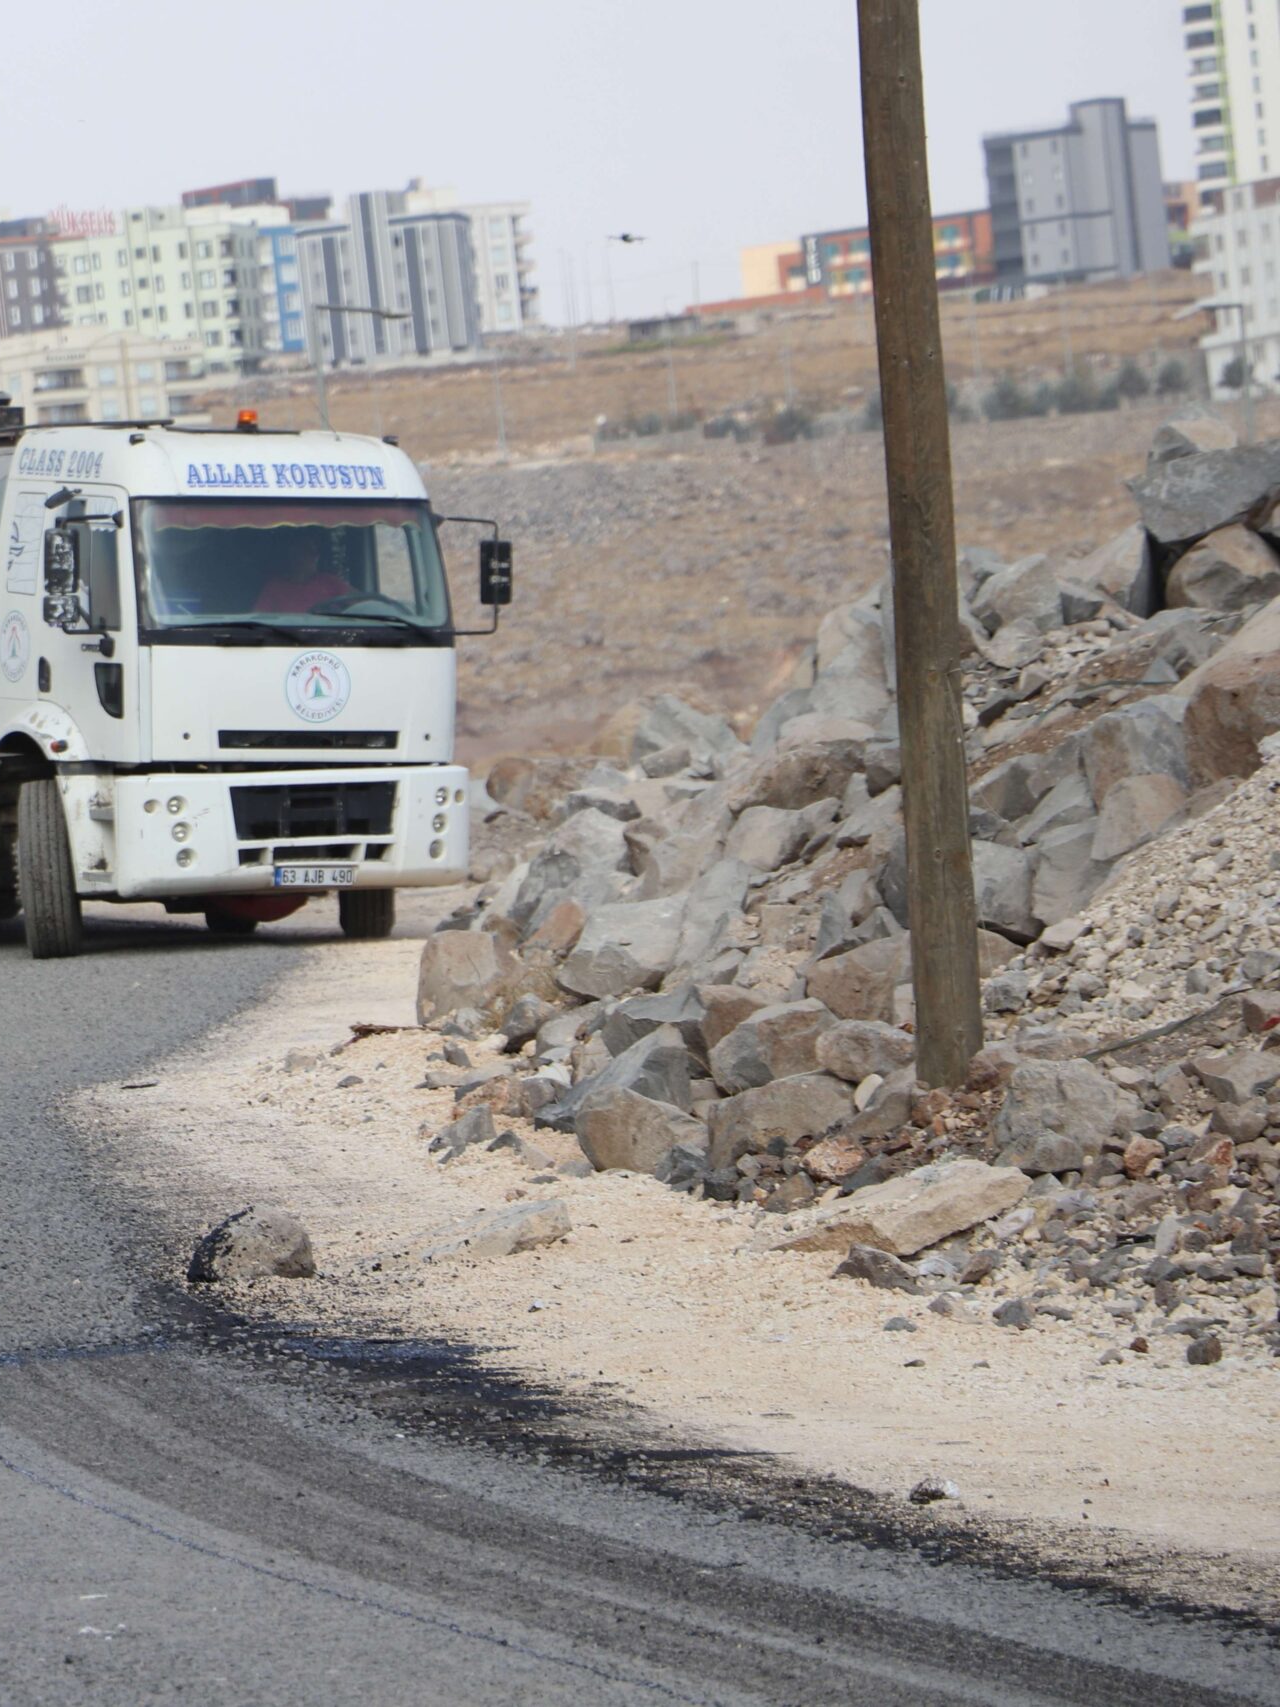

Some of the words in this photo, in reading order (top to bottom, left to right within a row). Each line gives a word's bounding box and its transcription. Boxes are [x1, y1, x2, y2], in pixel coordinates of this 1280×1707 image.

[19, 447, 65, 476] CLASS
[187, 463, 269, 488] ALLAH
[272, 463, 386, 489] KORUSUN
[282, 869, 296, 883] 63
[304, 869, 324, 883] AJB
[332, 869, 352, 883] 490
